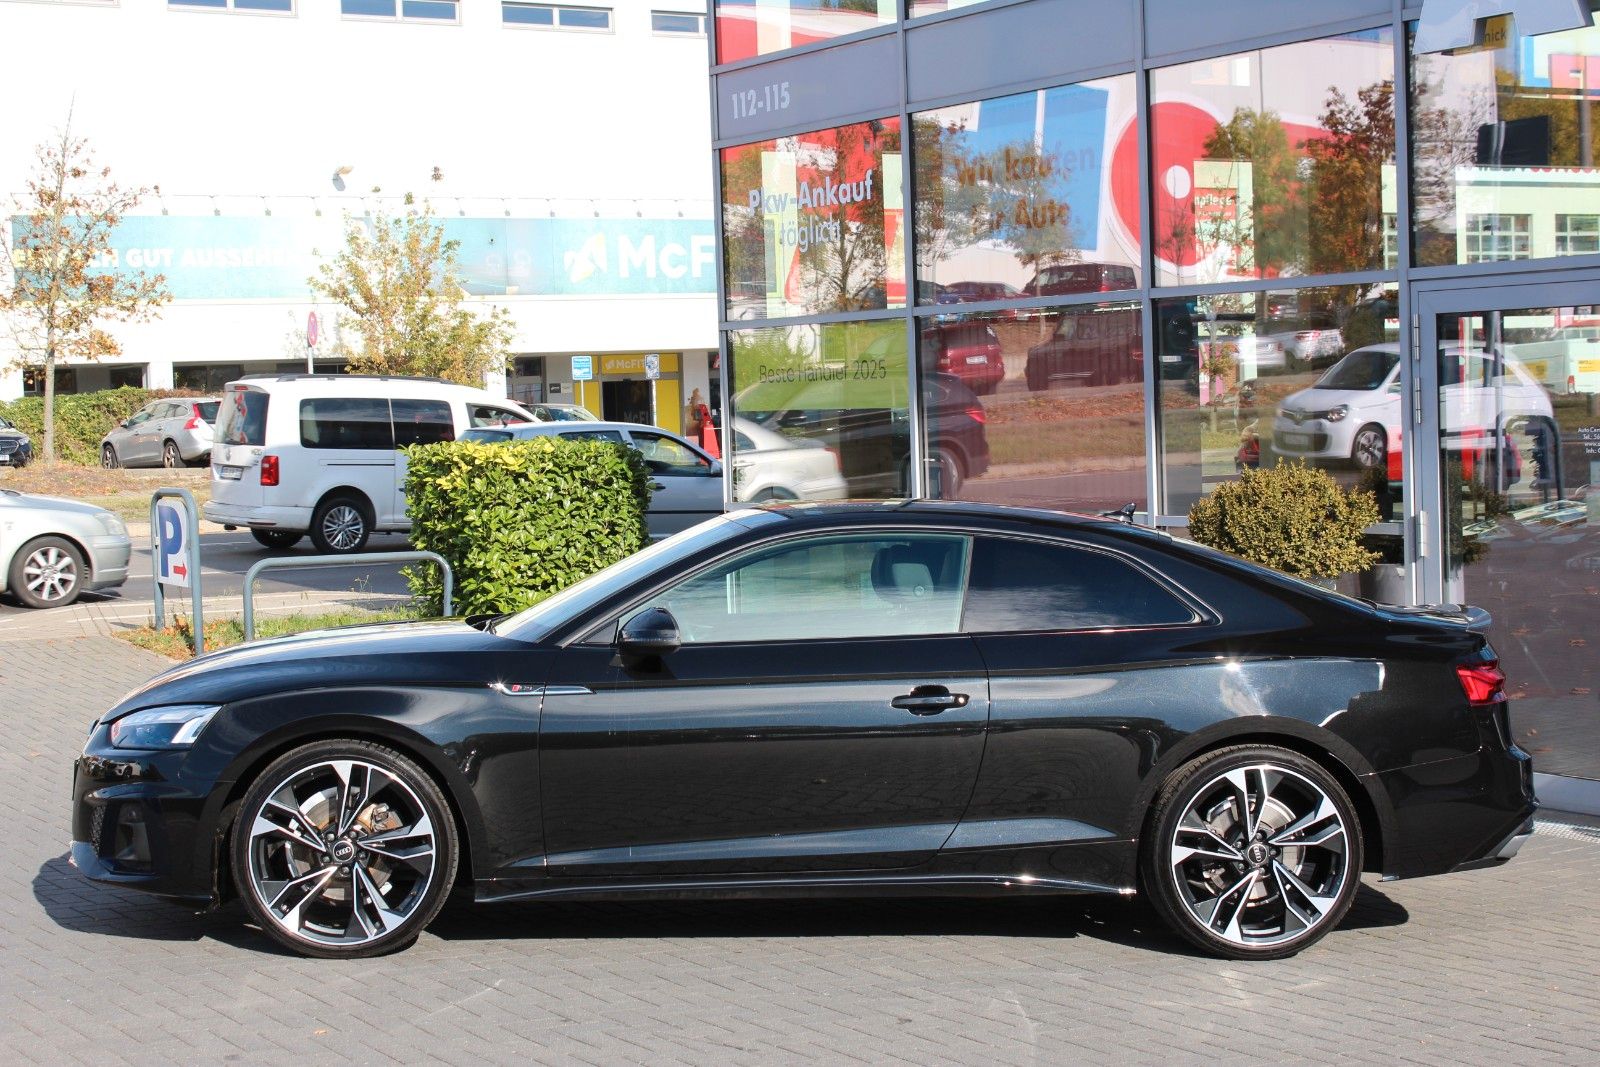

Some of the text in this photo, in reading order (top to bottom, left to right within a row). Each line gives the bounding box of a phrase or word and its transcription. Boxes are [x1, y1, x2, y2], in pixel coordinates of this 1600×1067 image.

[732, 82, 790, 119] 112-115
[749, 168, 873, 217] Pkw-Ankauf
[126, 247, 173, 268] GUT
[758, 365, 795, 384] Beste
[853, 358, 887, 380] 2025
[158, 506, 182, 577] P
